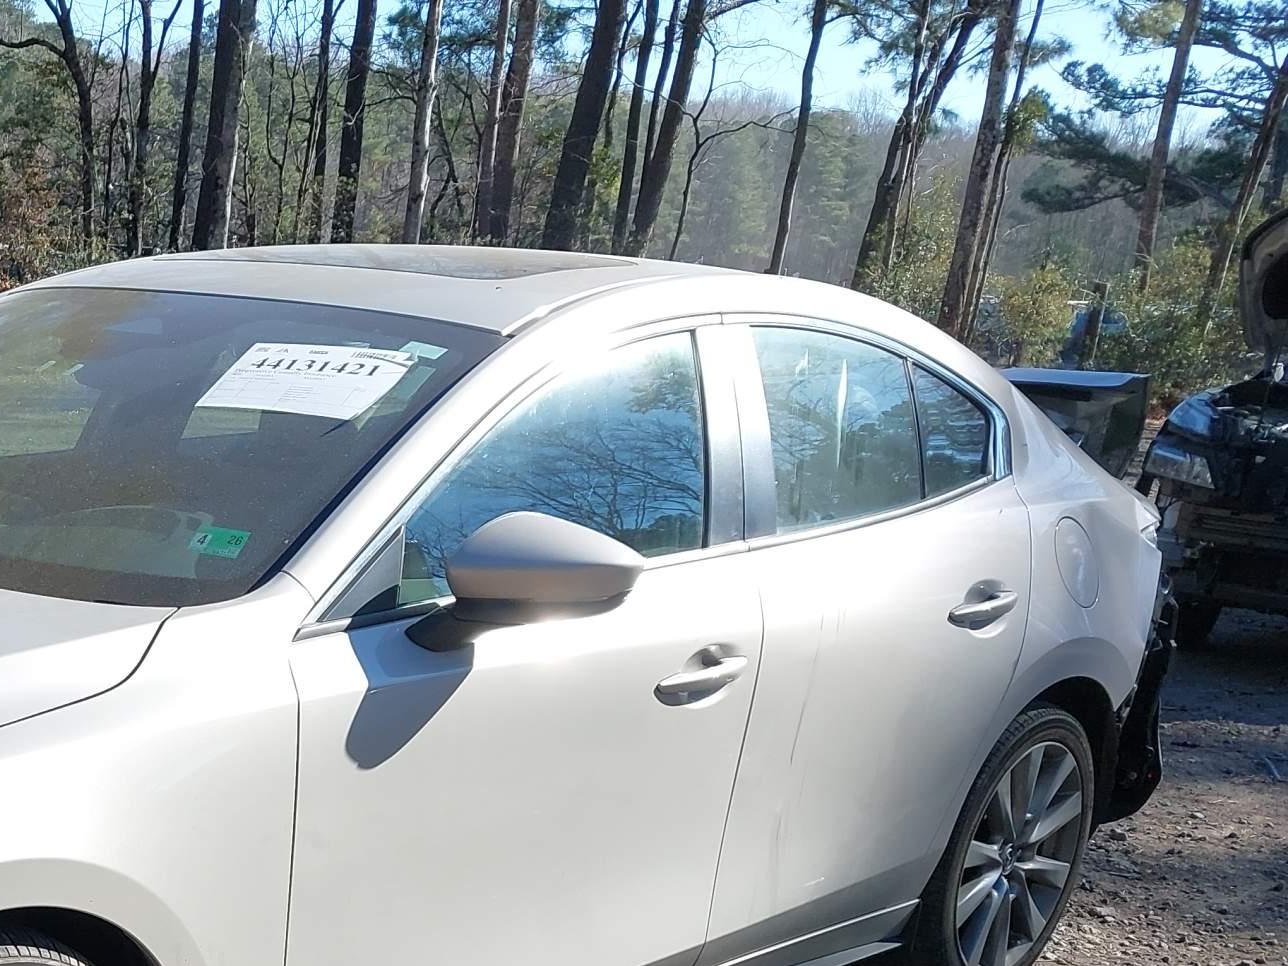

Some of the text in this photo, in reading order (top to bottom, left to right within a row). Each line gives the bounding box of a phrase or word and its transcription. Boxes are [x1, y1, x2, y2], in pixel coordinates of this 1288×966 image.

[251, 357, 381, 376] 44131421
[196, 534, 244, 546] 4 26
